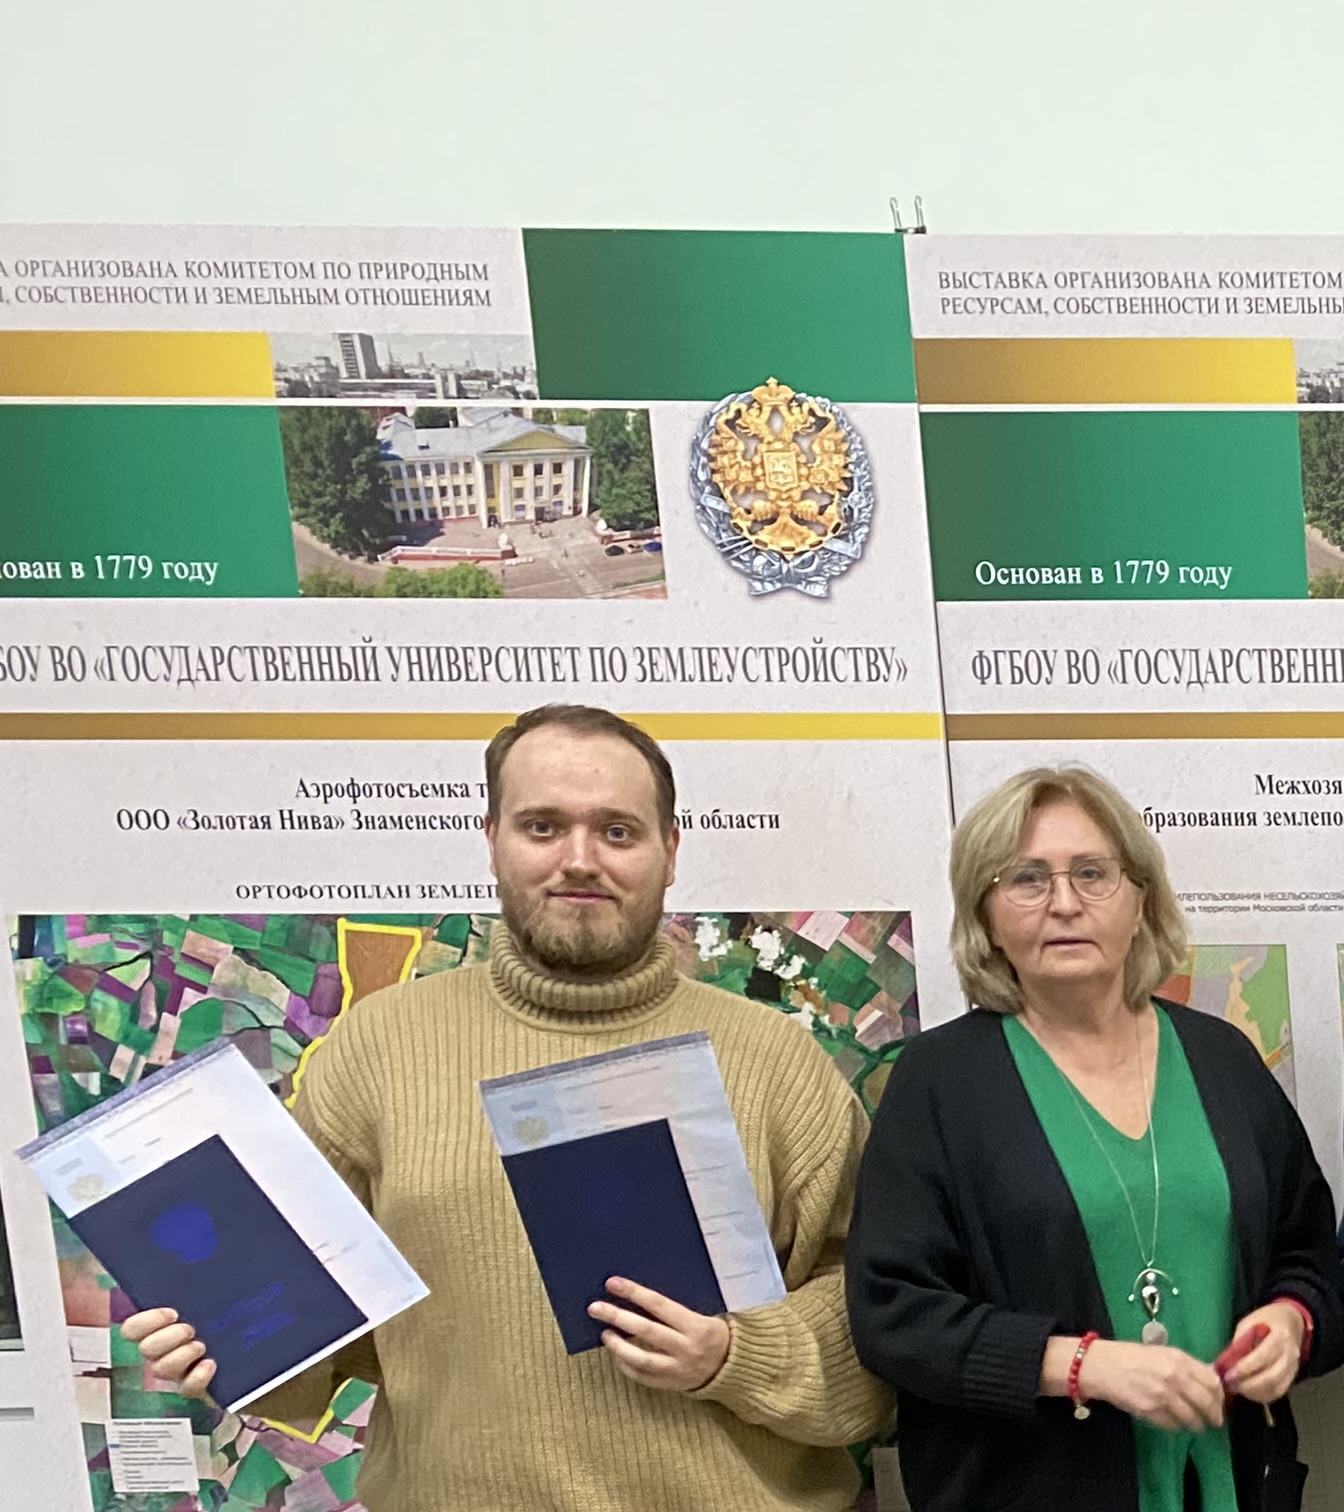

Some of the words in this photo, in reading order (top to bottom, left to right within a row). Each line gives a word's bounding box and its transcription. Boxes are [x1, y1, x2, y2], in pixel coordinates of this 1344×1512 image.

[15, 260, 177, 278] ОРГАНИЗОВАНА
[184, 261, 315, 278] КОМИТЕТОМ
[322, 262, 350, 279] ПО
[358, 262, 488, 282] ПРИРОДНЫМ
[938, 271, 1047, 289] ВЫСТАВКА
[1054, 271, 1211, 288] ОРГАНИЗОВАНА
[1218, 271, 1342, 288] КОМИТЕТОМ
[15, 285, 187, 303] СОБСТВЕННОСТИ
[194, 287, 207, 303] И
[213, 287, 339, 305] ЗЕМЕЛЬНЫМ
[345, 288, 491, 306] ОТНОШЕНИЯМ
[941, 297, 1048, 314] РЕСУРСАМ,
[1053, 296, 1218, 314] СОБСТВЕННОСТИ
[1226, 297, 1237, 313] И
[0, 561, 61, 579] ован
[70, 561, 84, 578] в
[95, 555, 152, 579] 1779
[161, 562, 217, 585] году
[975, 561, 1081, 586] Основан
[1091, 567, 1103, 583] в
[1114, 560, 1169, 583] 1779
[1179, 566, 1232, 589] году
[48, 645, 86, 682] ВО
[94, 639, 380, 687] «ГОСУДАРСТВЕННЫЙ
[385, 646, 580, 682] УНИВЕРСИТЕТ
[589, 646, 626, 682] ПО
[633, 637, 907, 683] ЗЕМЛЕУСТРОЙСТВУ»
[972, 649, 1057, 685] ФГБОУ
[1065, 649, 1100, 685] ВО
[296, 777, 470, 804] Аэрофотосъемка
[117, 808, 169, 830] ООО
[177, 809, 271, 830] «Золотая
[279, 809, 344, 829] Нива»
[351, 809, 484, 830] Знаменского
[700, 809, 779, 829] области
[1143, 807, 1256, 833] бразования
[236, 885, 410, 898] ОРТОФОТОПЛАН
